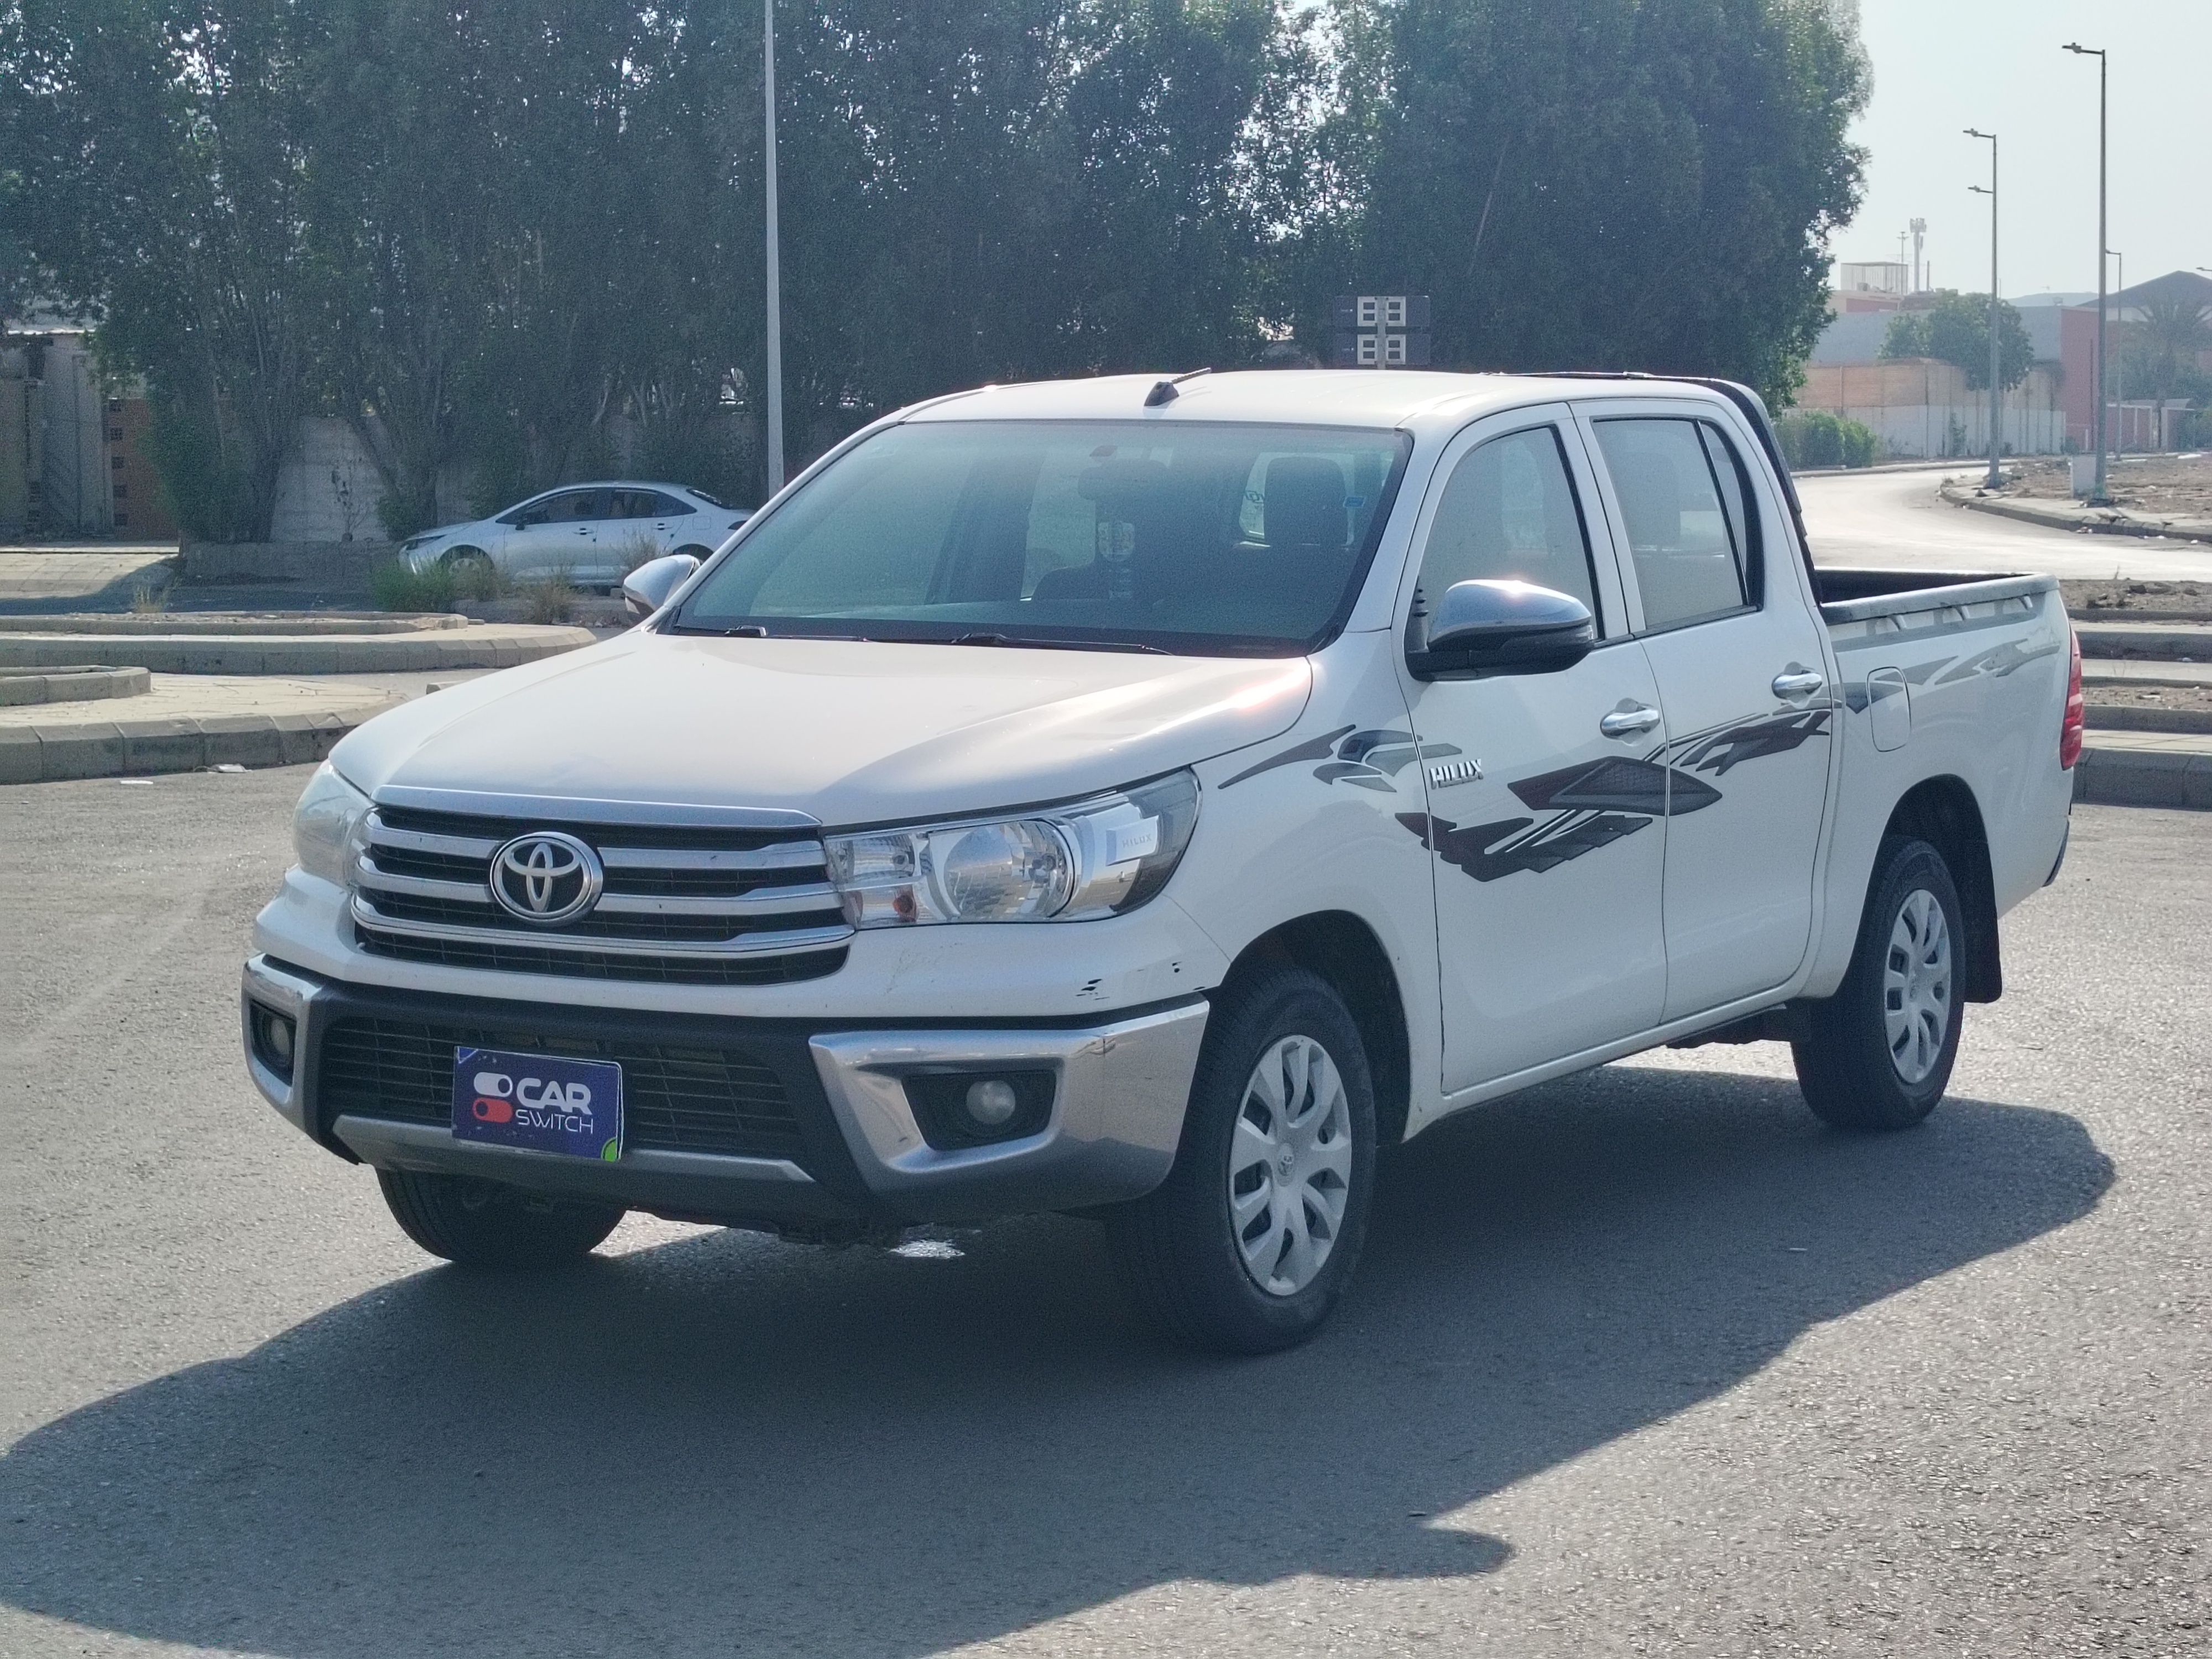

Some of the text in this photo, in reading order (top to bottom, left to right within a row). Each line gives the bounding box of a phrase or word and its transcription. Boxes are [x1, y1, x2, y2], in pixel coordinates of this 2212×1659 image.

[1429, 759, 1483, 790] HILUX
[1122, 833, 1152, 848] HILUX
[517, 1078, 592, 1115] CAR
[515, 1109, 593, 1134] SWITCH
